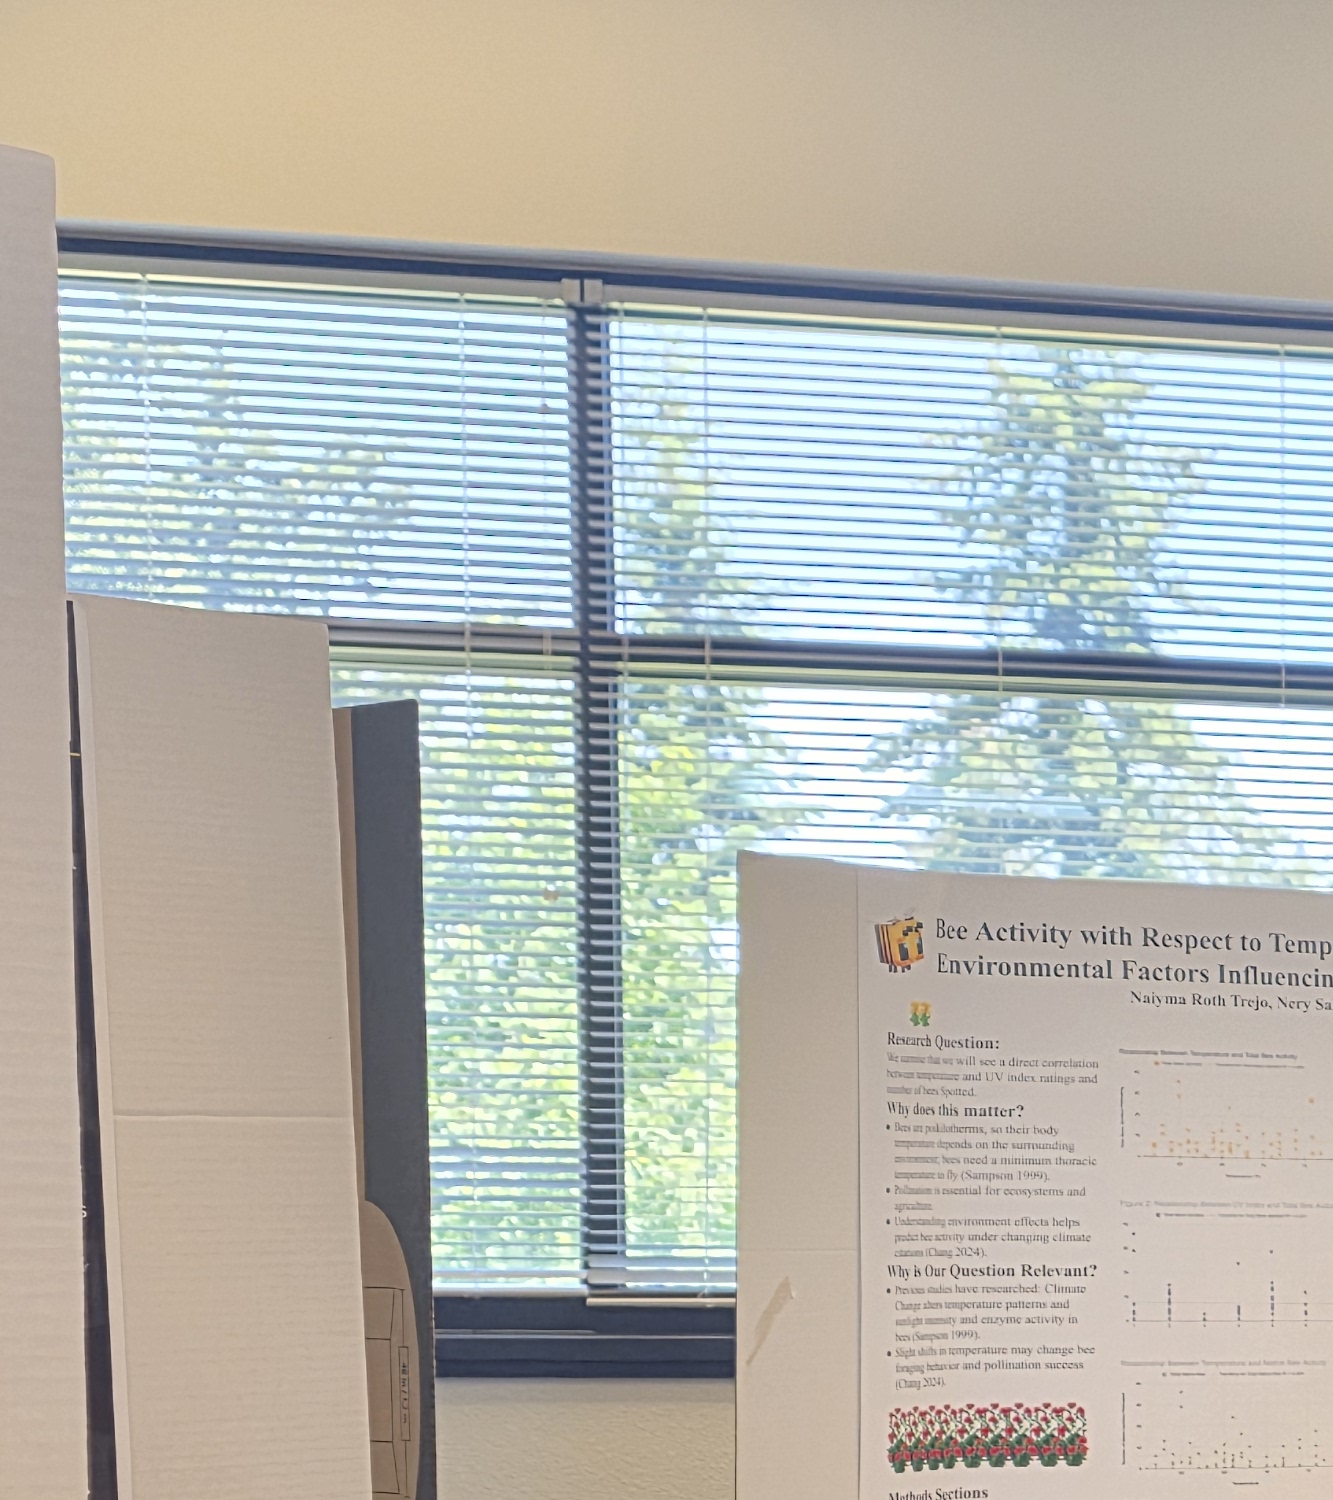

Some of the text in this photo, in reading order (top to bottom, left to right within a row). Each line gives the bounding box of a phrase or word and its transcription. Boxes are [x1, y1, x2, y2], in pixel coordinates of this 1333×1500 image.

[936, 918, 967, 940] Bee
[976, 922, 1073, 949] Activity
[1081, 926, 1131, 946] with
[1142, 927, 1232, 952] Respect
[1240, 933, 1261, 951] to
[937, 953, 1112, 979] Environmental
[1122, 961, 1209, 983] Factors
[1131, 991, 1186, 1007] Naiyma
[1192, 993, 1225, 1007] Roth
[1231, 994, 1272, 1011] Trejo,
[1277, 996, 1310, 1013] Nery
[888, 1032, 999, 1050] Research Question:
[956, 1056, 975, 1067] will
[1009, 1058, 1038, 1067] direct
[1042, 1059, 1099, 1068] correlation
[985, 1073, 1003, 1082] UV
[887, 1101, 1024, 1118] Why does this matter?
[1033, 1125, 1059, 1136] body
[888, 1264, 1097, 1280] Why is Our Question Relevant?
[1045, 1284, 1086, 1293] Climate
[936, 1487, 988, 1500] Sections
